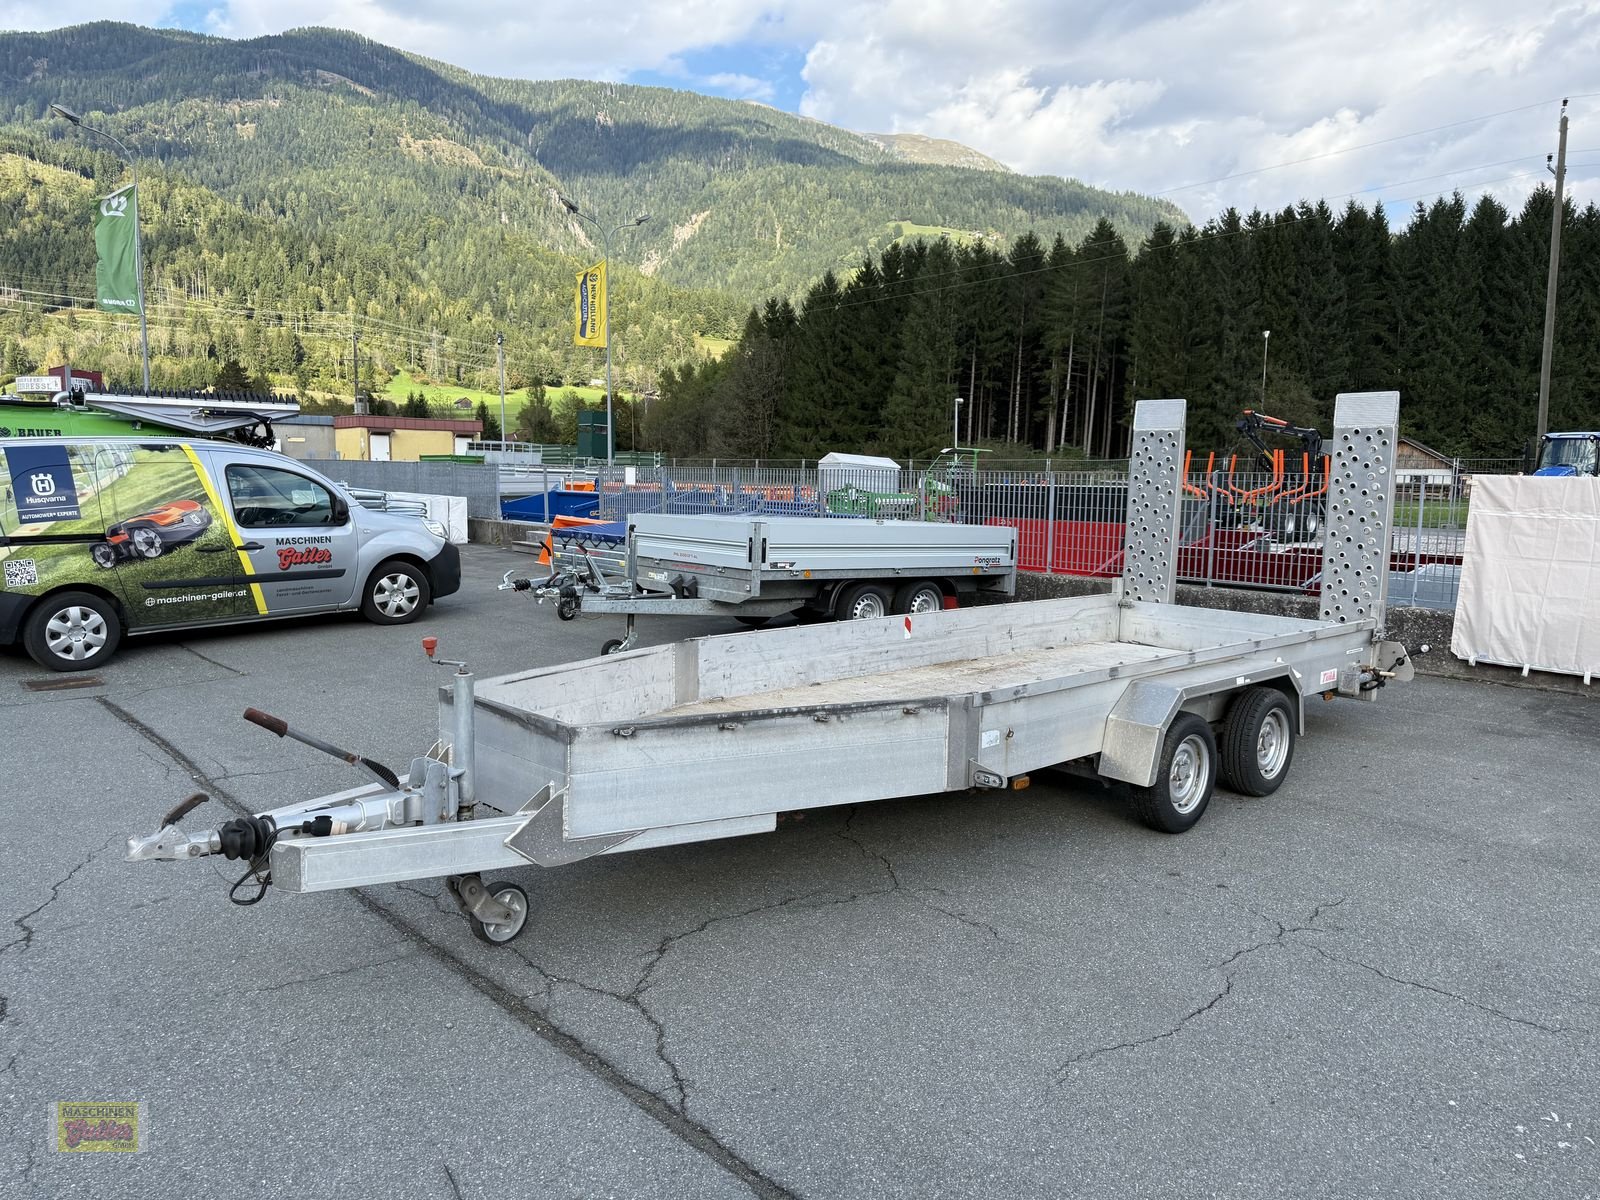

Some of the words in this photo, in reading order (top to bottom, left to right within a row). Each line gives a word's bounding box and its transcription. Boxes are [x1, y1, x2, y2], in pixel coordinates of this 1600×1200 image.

[17, 428, 62, 437] BAUER
[26, 495, 67, 504] Husqvarna
[275, 536, 332, 546] MASCHINEN
[276, 546, 332, 571] Gailer
[156, 589, 248, 605] maschinen-gailer.at
